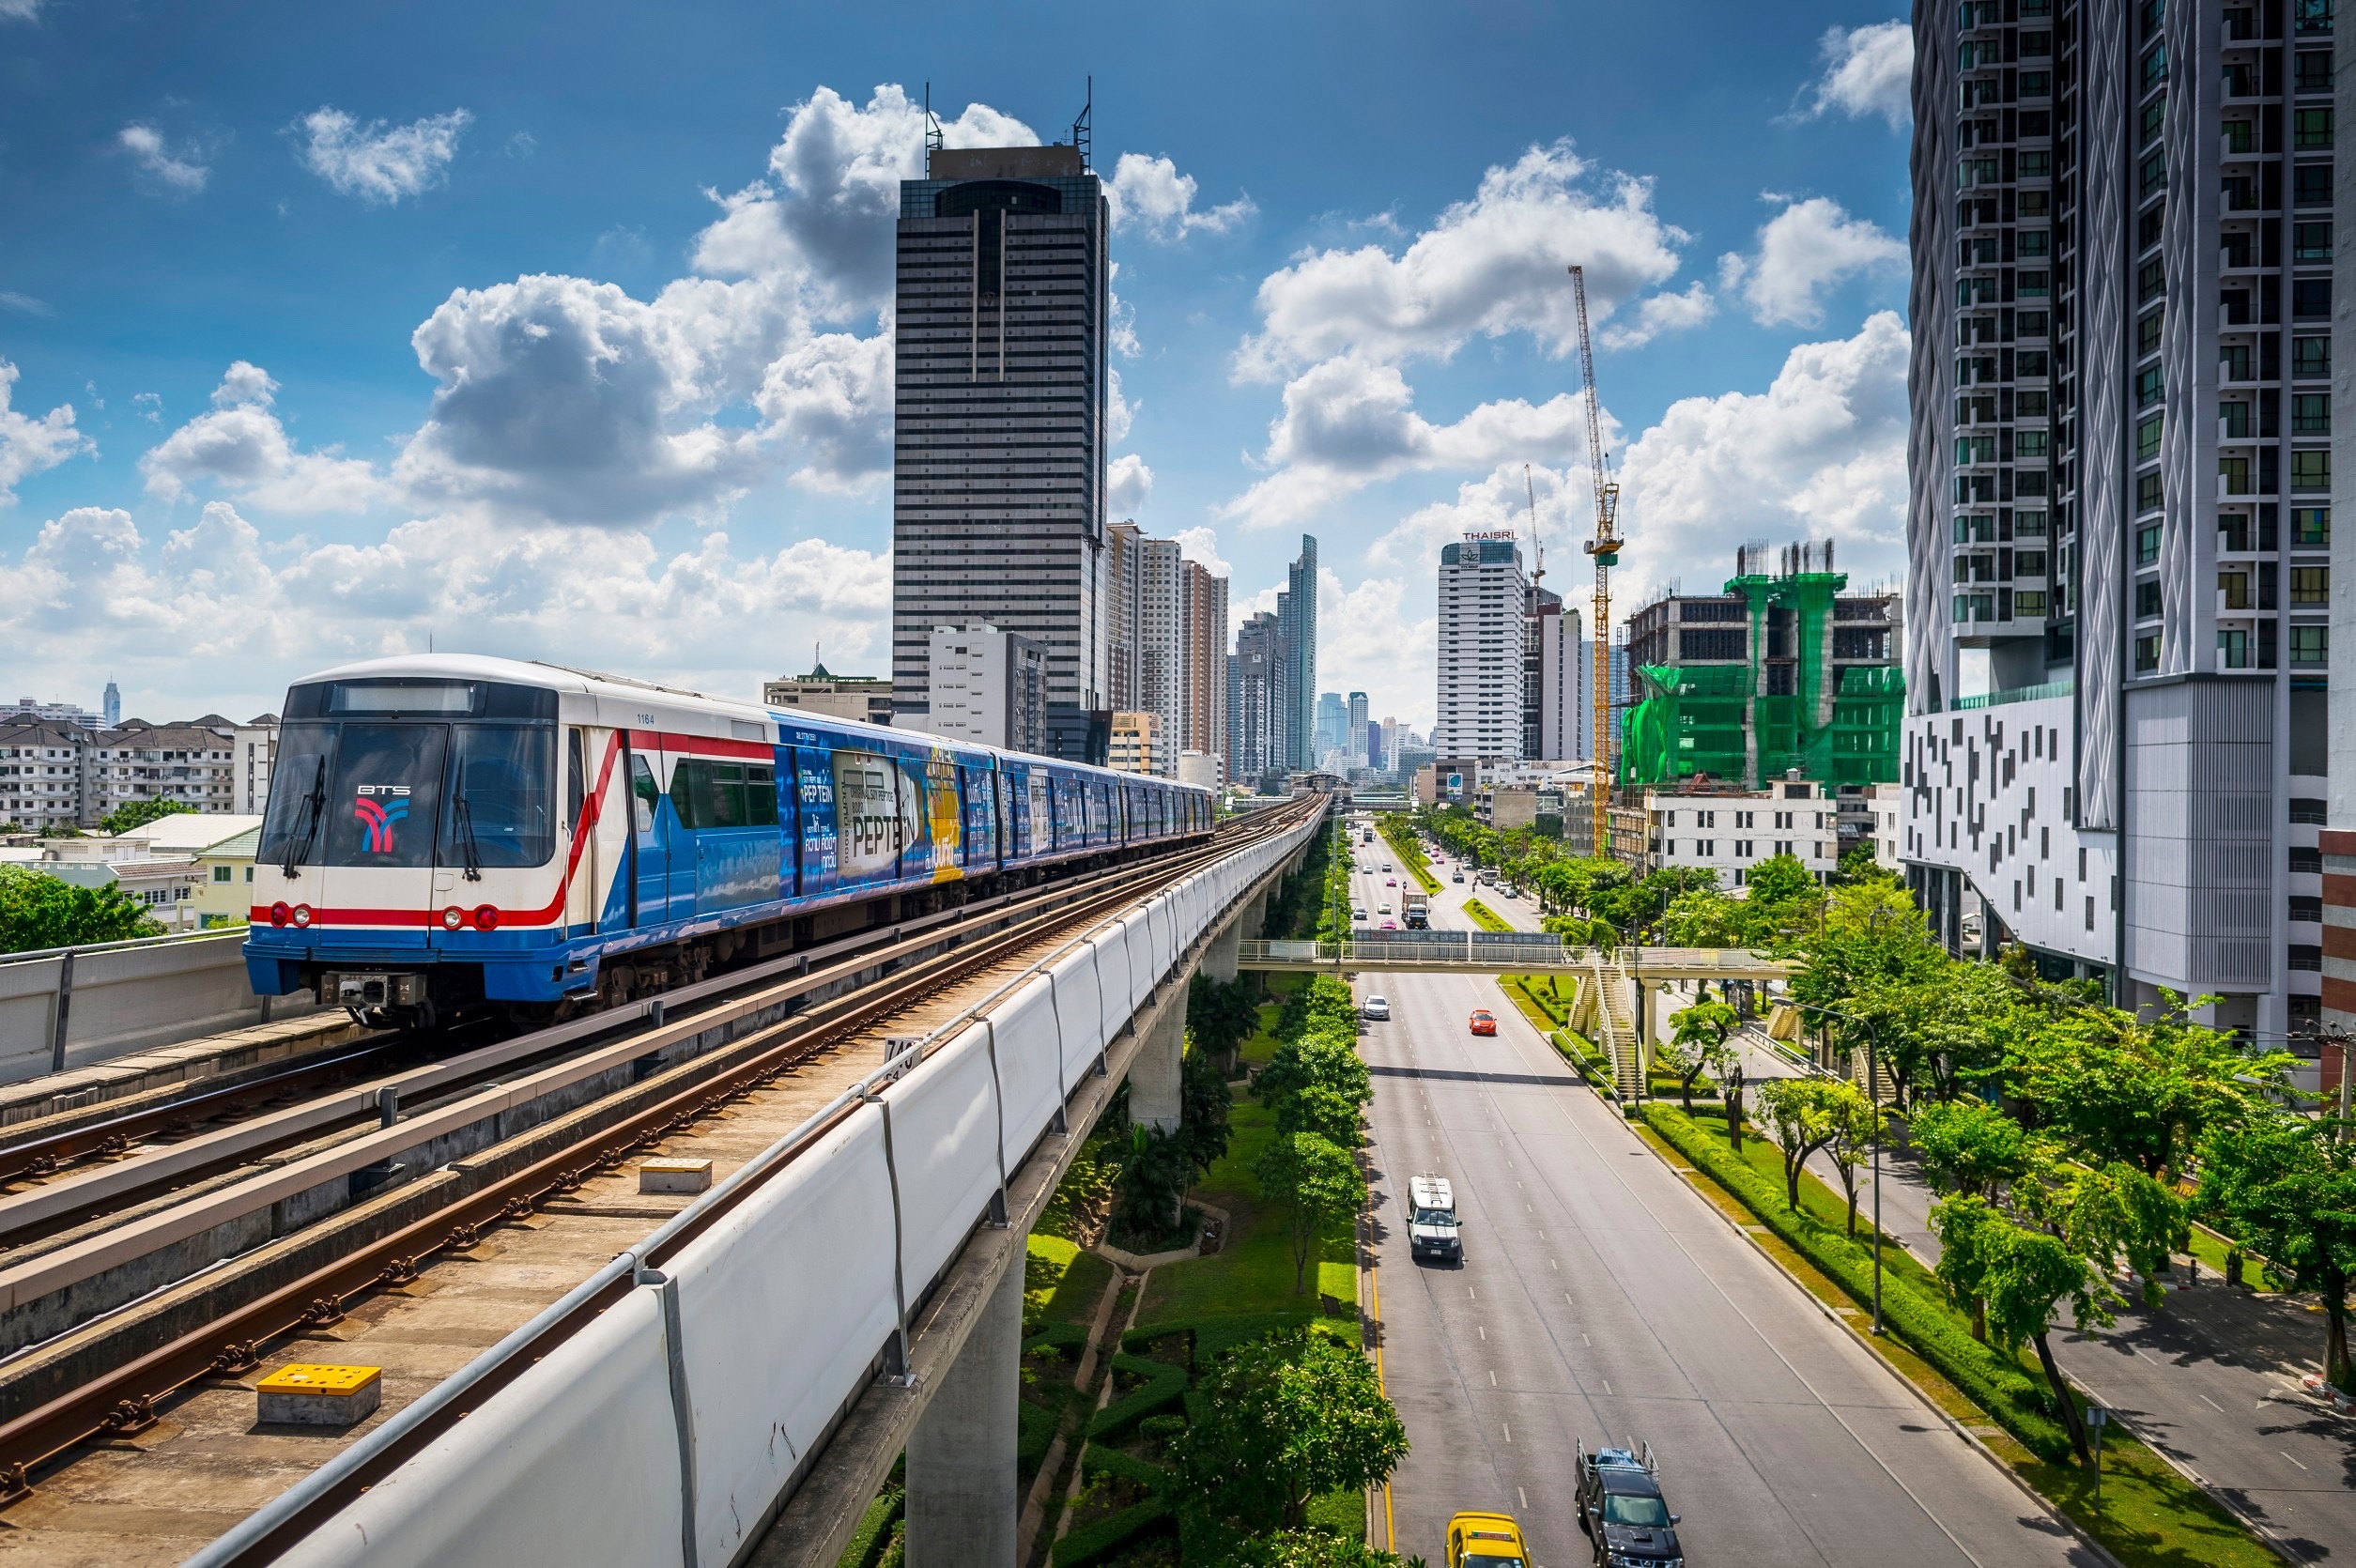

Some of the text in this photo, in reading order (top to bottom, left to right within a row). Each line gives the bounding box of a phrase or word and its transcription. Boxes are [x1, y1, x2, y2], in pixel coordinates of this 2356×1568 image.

[1462, 530, 1515, 541] THAISRI
[638, 713, 654, 725] 1164
[357, 785, 411, 795] BTS
